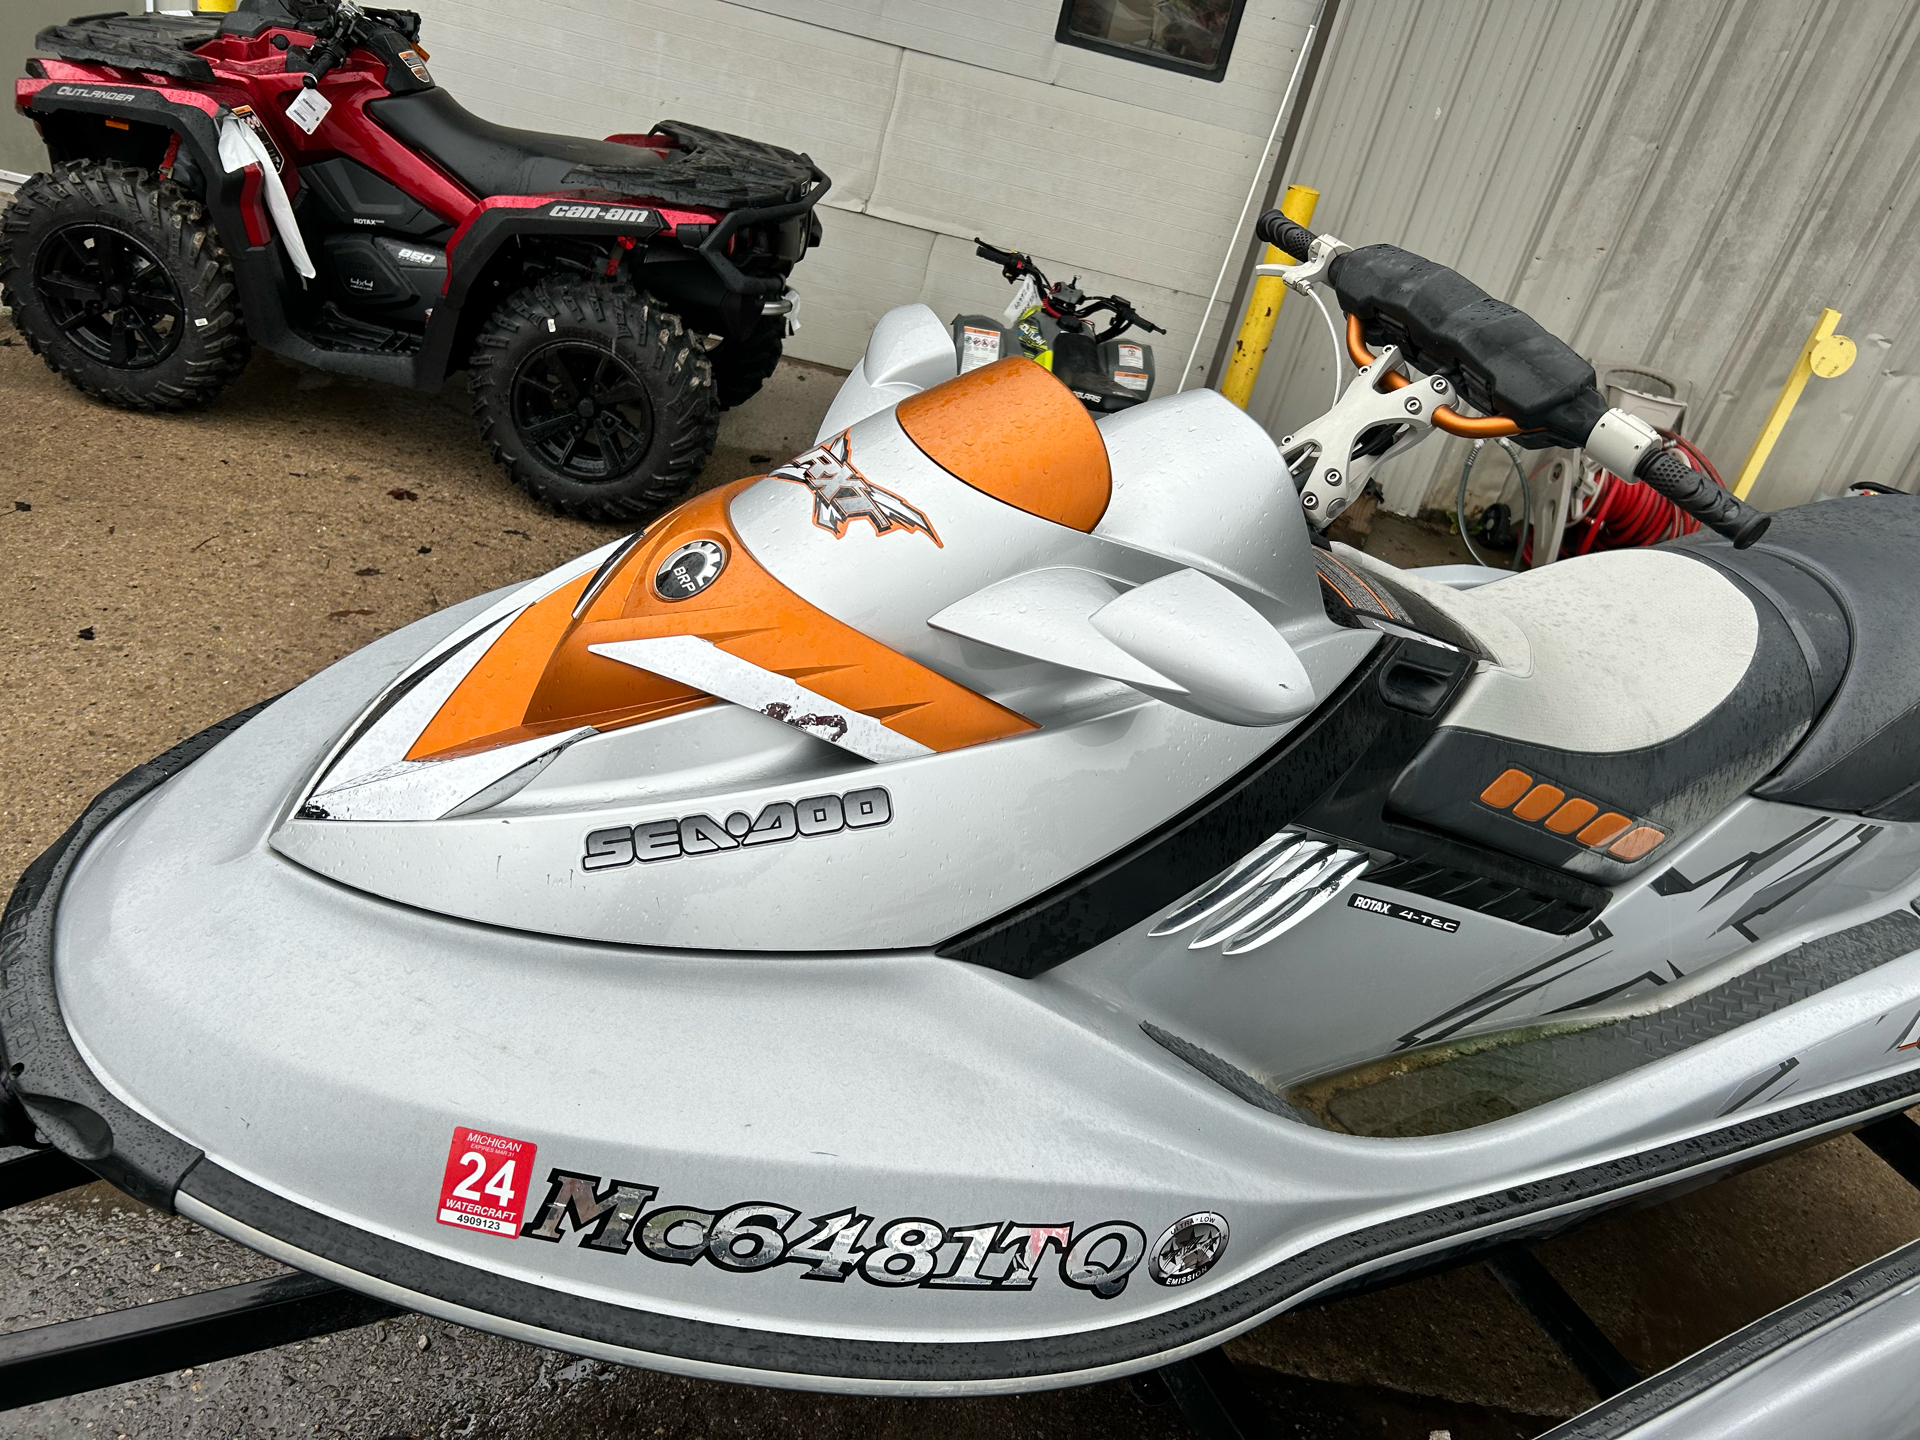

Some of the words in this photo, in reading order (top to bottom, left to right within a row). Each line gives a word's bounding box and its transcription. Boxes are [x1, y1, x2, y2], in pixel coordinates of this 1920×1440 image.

[56, 86, 135, 102] OUTLANDER
[353, 218, 377, 226] ROTAX
[549, 205, 649, 223] can-am
[1020, 322, 1047, 346] OUTLAW
[792, 445, 893, 529] RXT
[673, 565, 697, 592] BRP
[1354, 896, 1392, 914] ROTAX
[1398, 910, 1457, 932] 4-TEC
[467, 1132, 522, 1153] MICHIGAN
[470, 1143, 494, 1153] EXPIRES
[452, 1151, 517, 1207] 24
[446, 1198, 517, 1221] WATERCRAFT
[456, 1214, 501, 1231] 4909123
[1170, 1218, 1195, 1235] ULTRA
[1200, 1216, 1216, 1224] LOW
[1165, 1265, 1208, 1286] EMISSION
